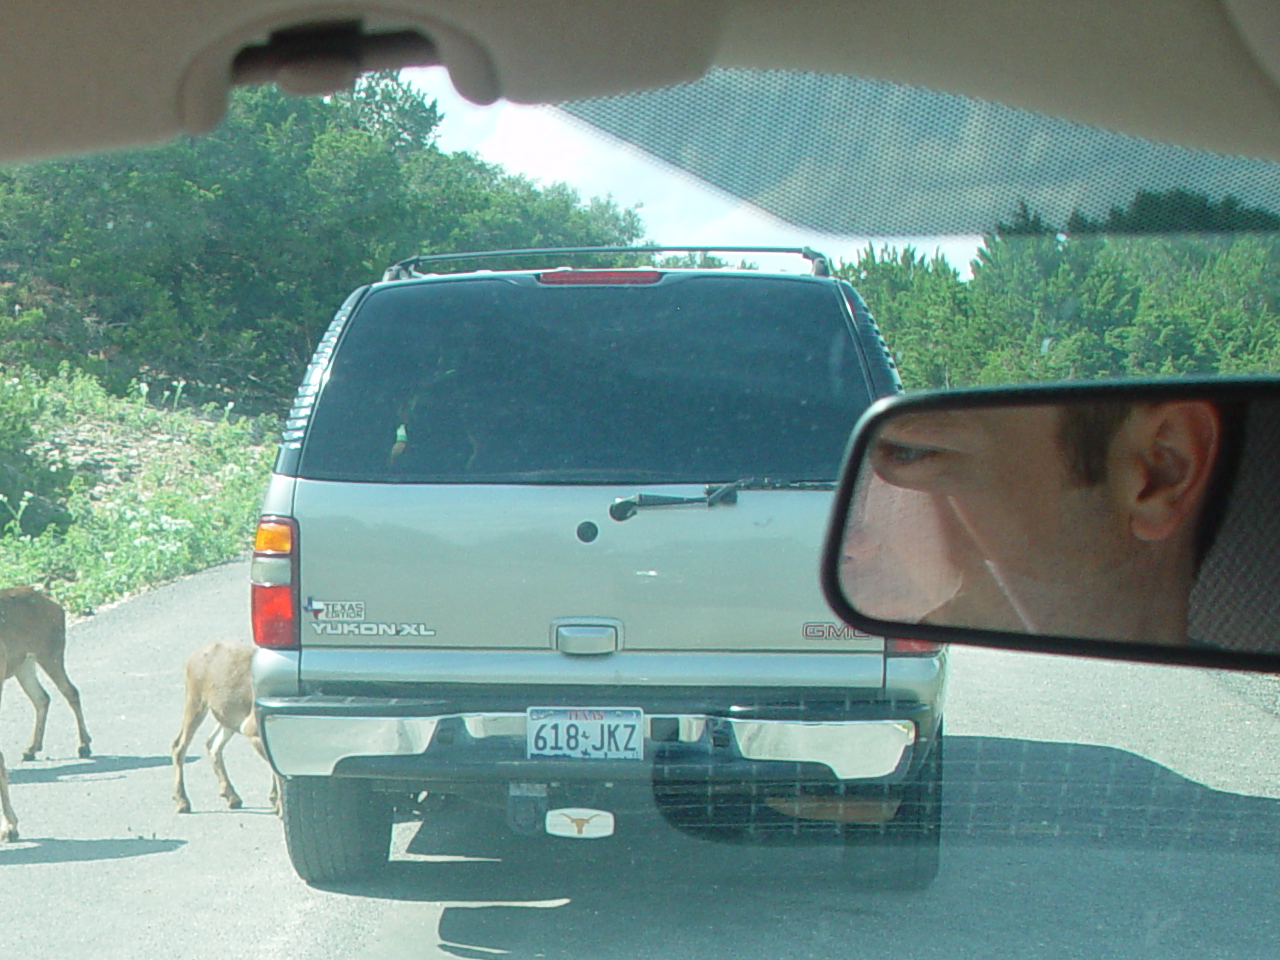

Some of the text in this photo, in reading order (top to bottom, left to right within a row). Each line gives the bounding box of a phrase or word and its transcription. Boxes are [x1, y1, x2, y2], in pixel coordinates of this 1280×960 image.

[323, 602, 363, 612] TEXAS
[325, 611, 362, 619] EDITION
[310, 622, 436, 636] YUKON XL
[568, 711, 604, 720] TEXAS
[534, 723, 637, 752] 618 JKZ
